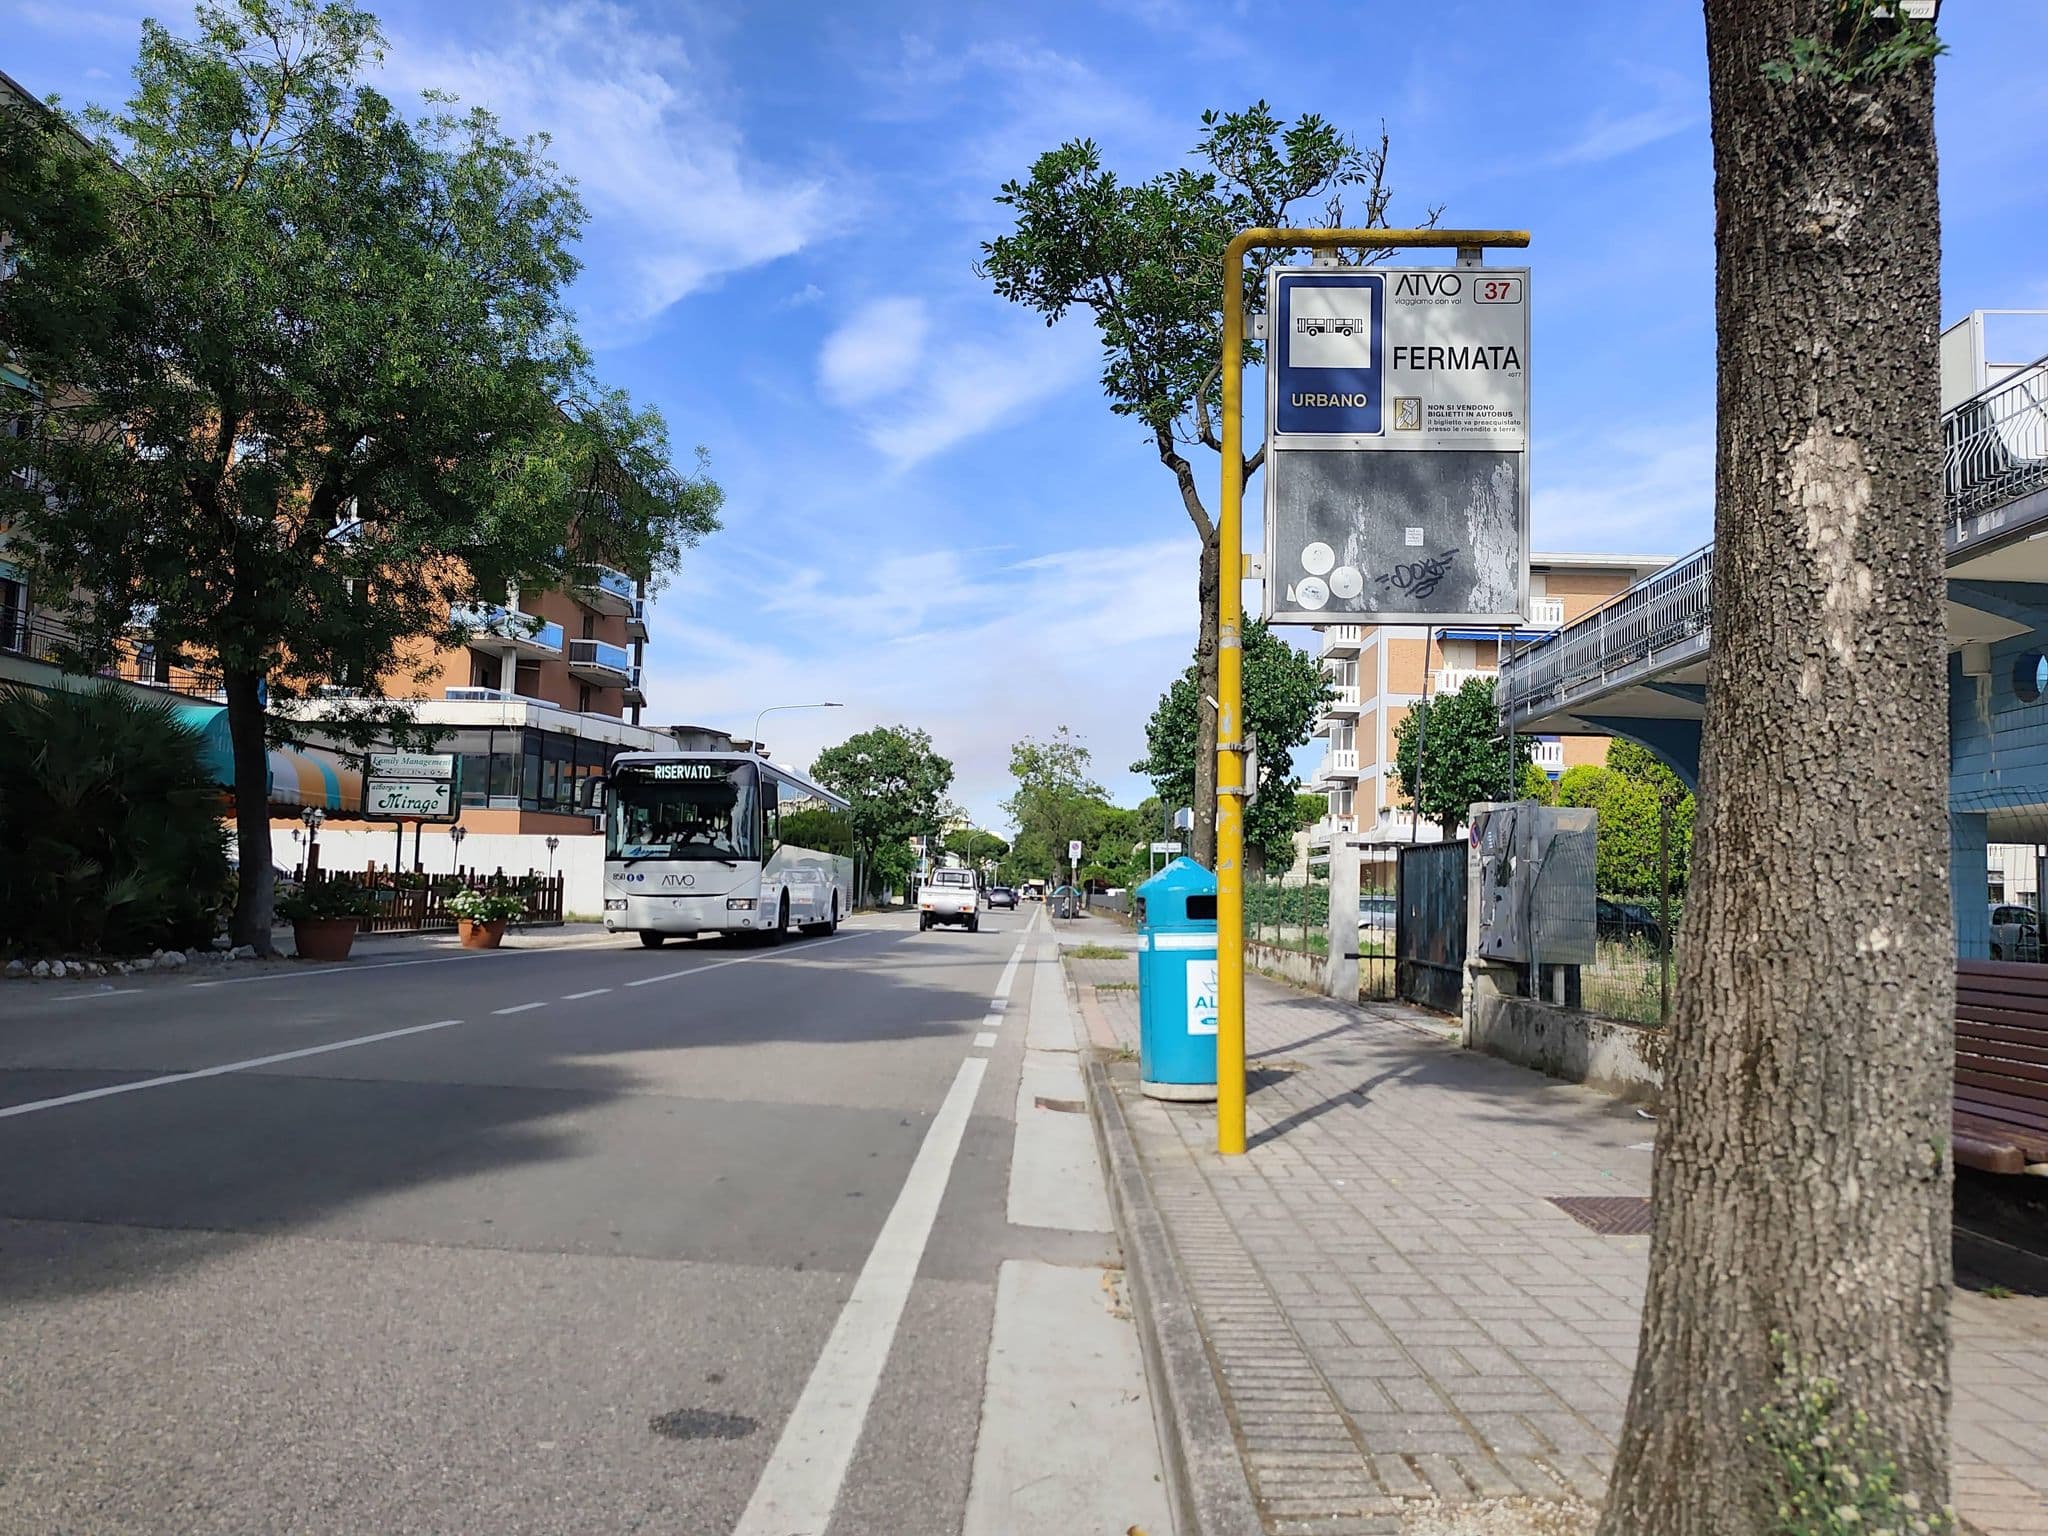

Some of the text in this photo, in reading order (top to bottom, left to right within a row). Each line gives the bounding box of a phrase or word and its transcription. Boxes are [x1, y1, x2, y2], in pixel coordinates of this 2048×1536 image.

[1395, 274, 1462, 296] ATVO
[1484, 282, 1511, 300] 37
[1395, 298, 1433, 306] viaggiamo
[1393, 346, 1521, 370] FERMATA
[1291, 393, 1367, 408] URBANO
[1433, 419, 1462, 428] biglietto
[372, 757, 451, 768] Family Management
[654, 765, 711, 779] RISERVATO
[378, 793, 439, 813] Mirage
[661, 874, 695, 886] ATVO
